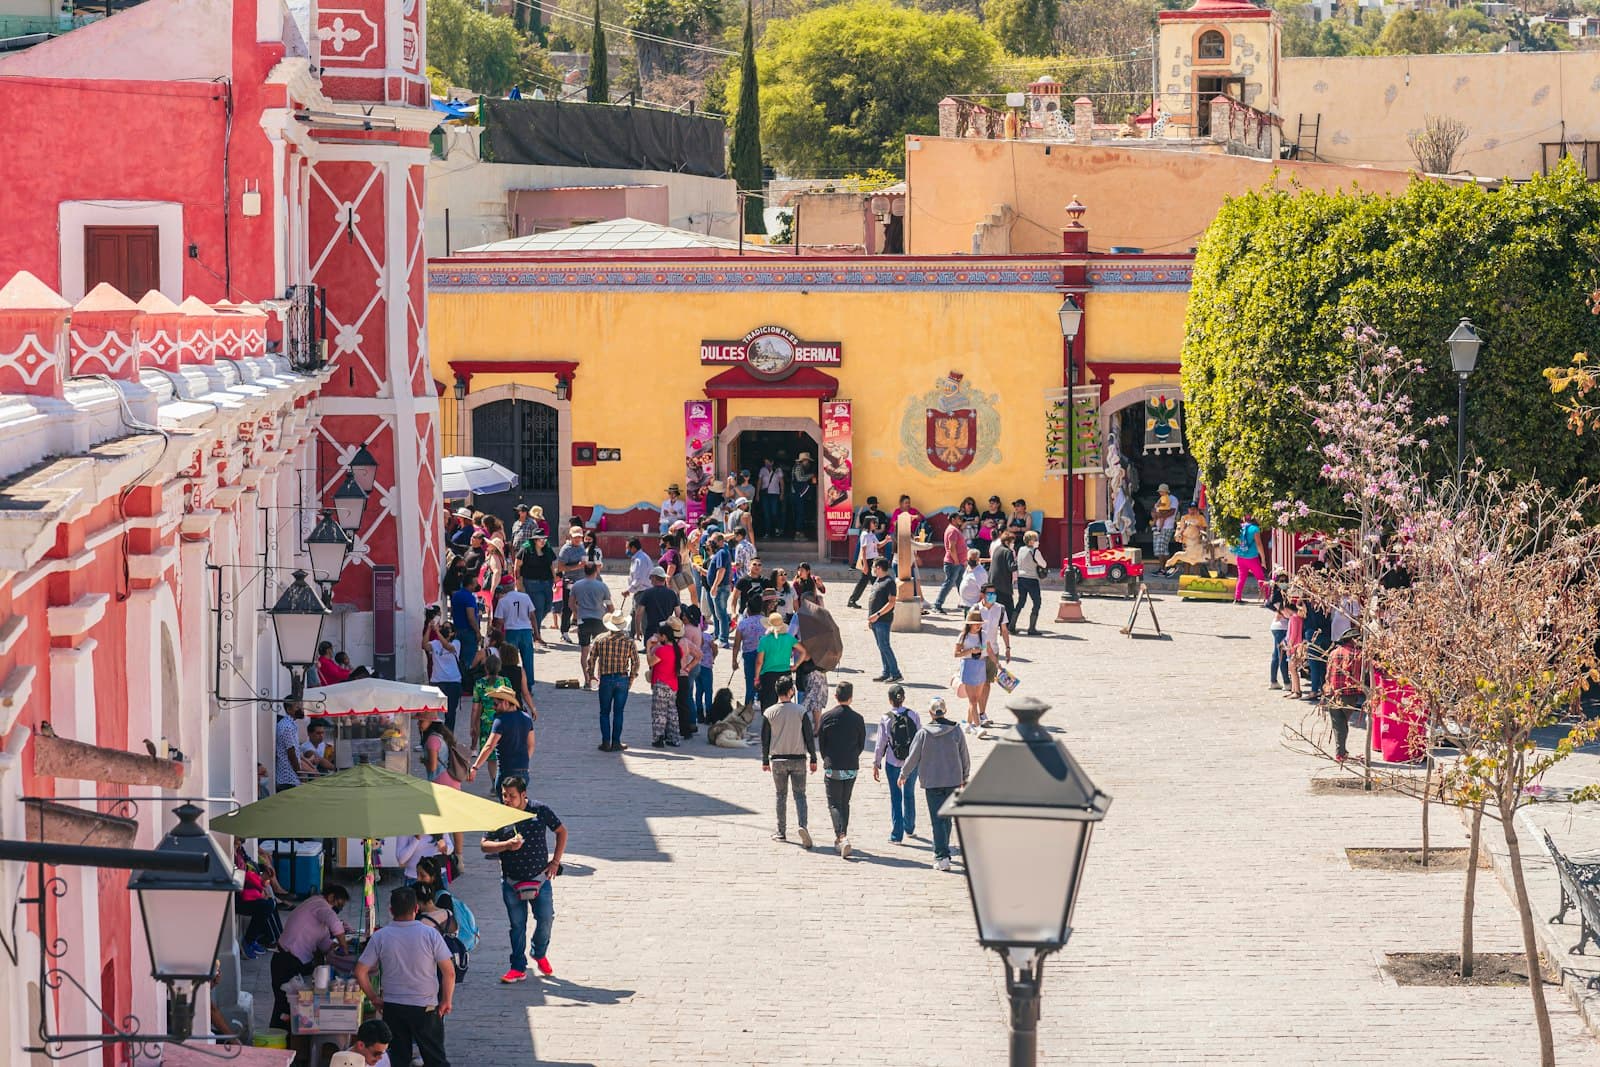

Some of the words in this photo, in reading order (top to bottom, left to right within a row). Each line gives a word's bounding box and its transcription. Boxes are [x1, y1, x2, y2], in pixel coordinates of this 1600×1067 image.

[742, 326, 799, 345] TRADICIONALES
[700, 346, 745, 360] DULCES
[795, 347, 840, 361] BERNAL
[513, 601, 520, 618] 7
